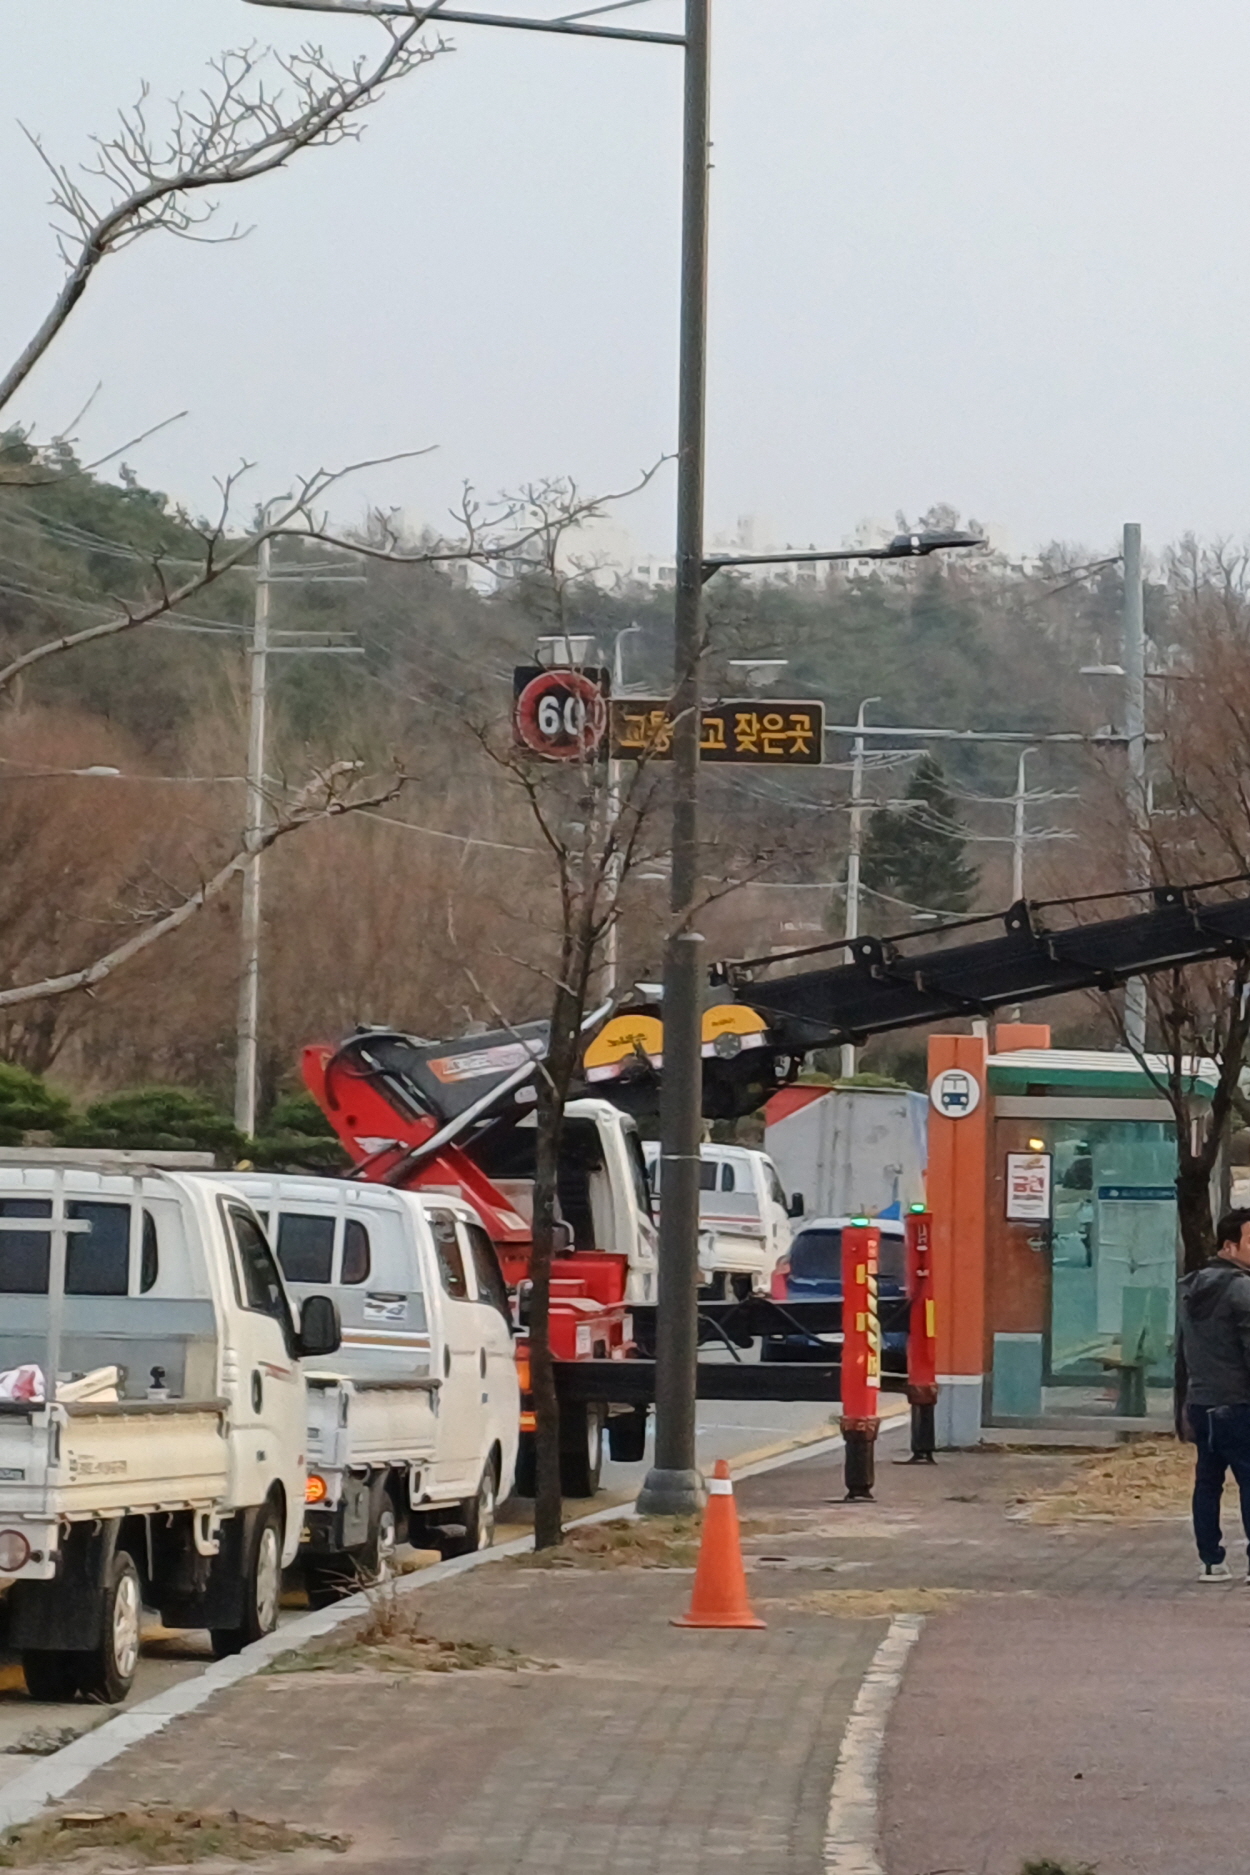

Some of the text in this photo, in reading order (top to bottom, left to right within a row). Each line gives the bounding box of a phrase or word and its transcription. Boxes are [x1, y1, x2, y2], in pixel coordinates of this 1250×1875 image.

[538, 695, 586, 736] 60
[620, 711, 814, 754] 교통고 잦은곳
